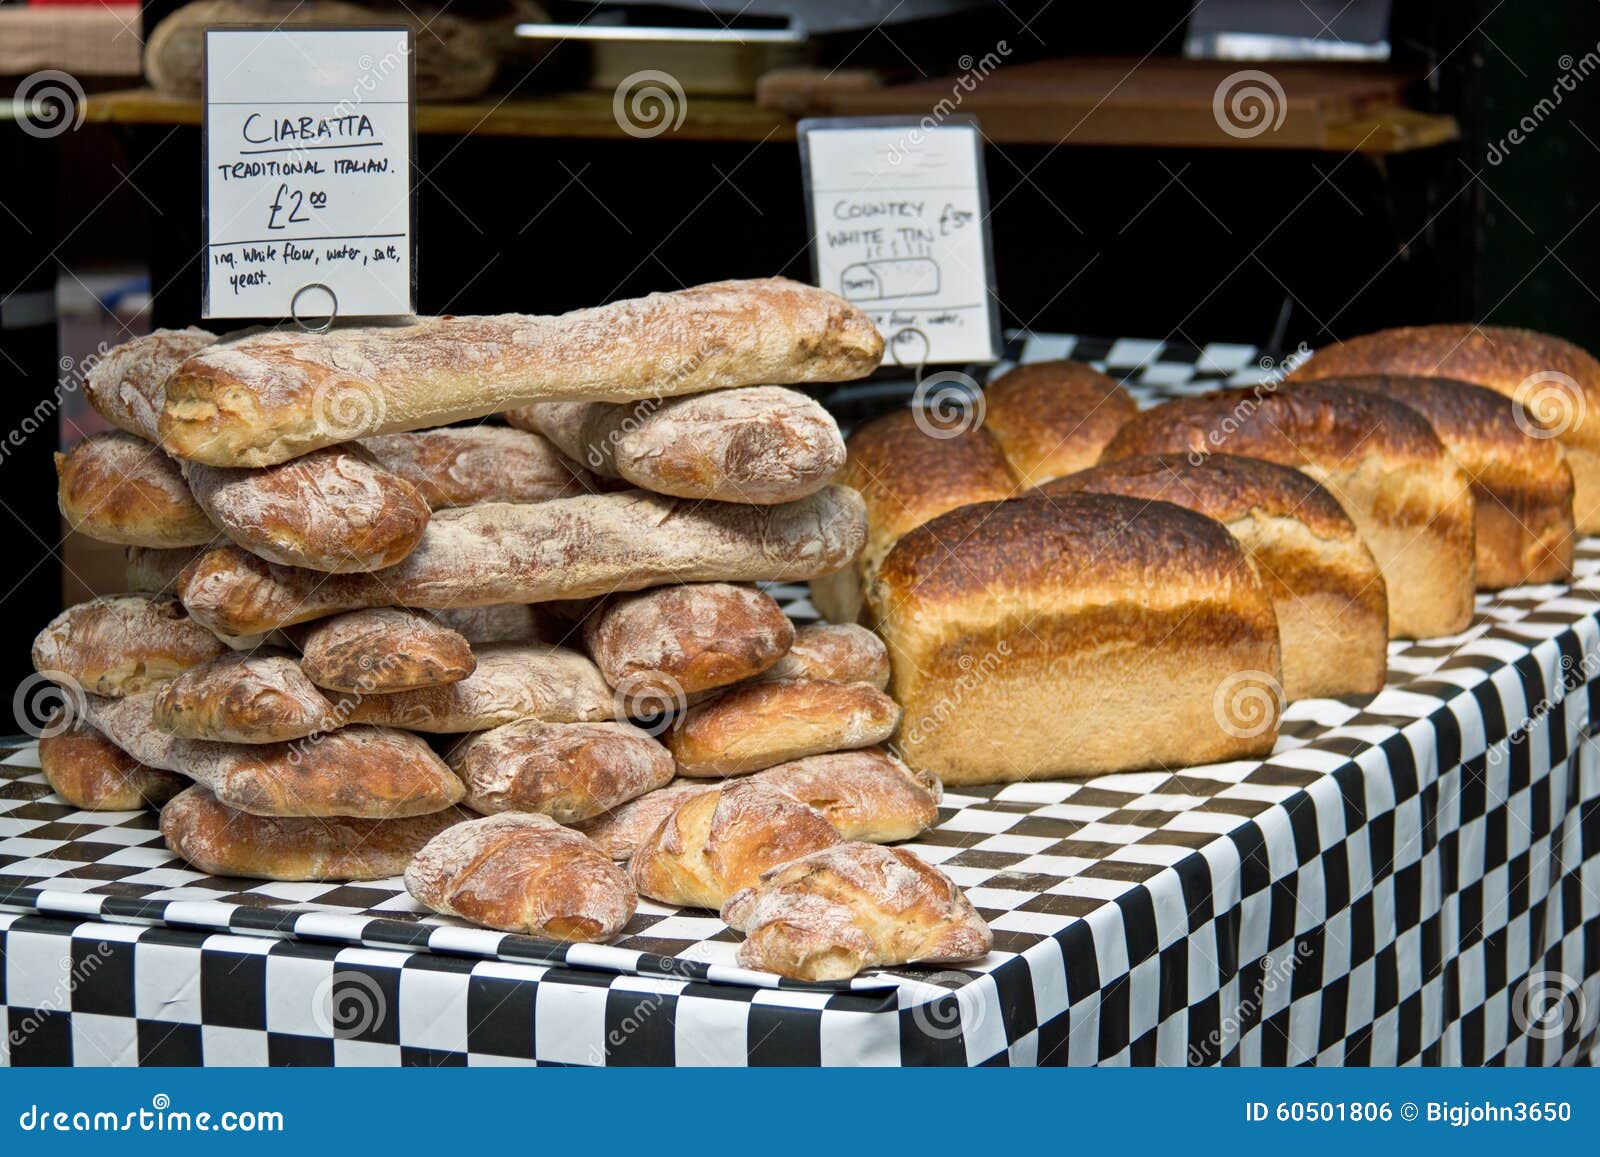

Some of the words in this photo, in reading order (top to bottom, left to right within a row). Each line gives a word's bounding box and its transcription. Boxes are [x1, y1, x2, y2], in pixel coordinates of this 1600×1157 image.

[243, 113, 374, 144] CIABATTA
[218, 160, 325, 180] TRADITIONAL
[833, 201, 925, 220] COUNTRY
[826, 227, 884, 248] WHITE
